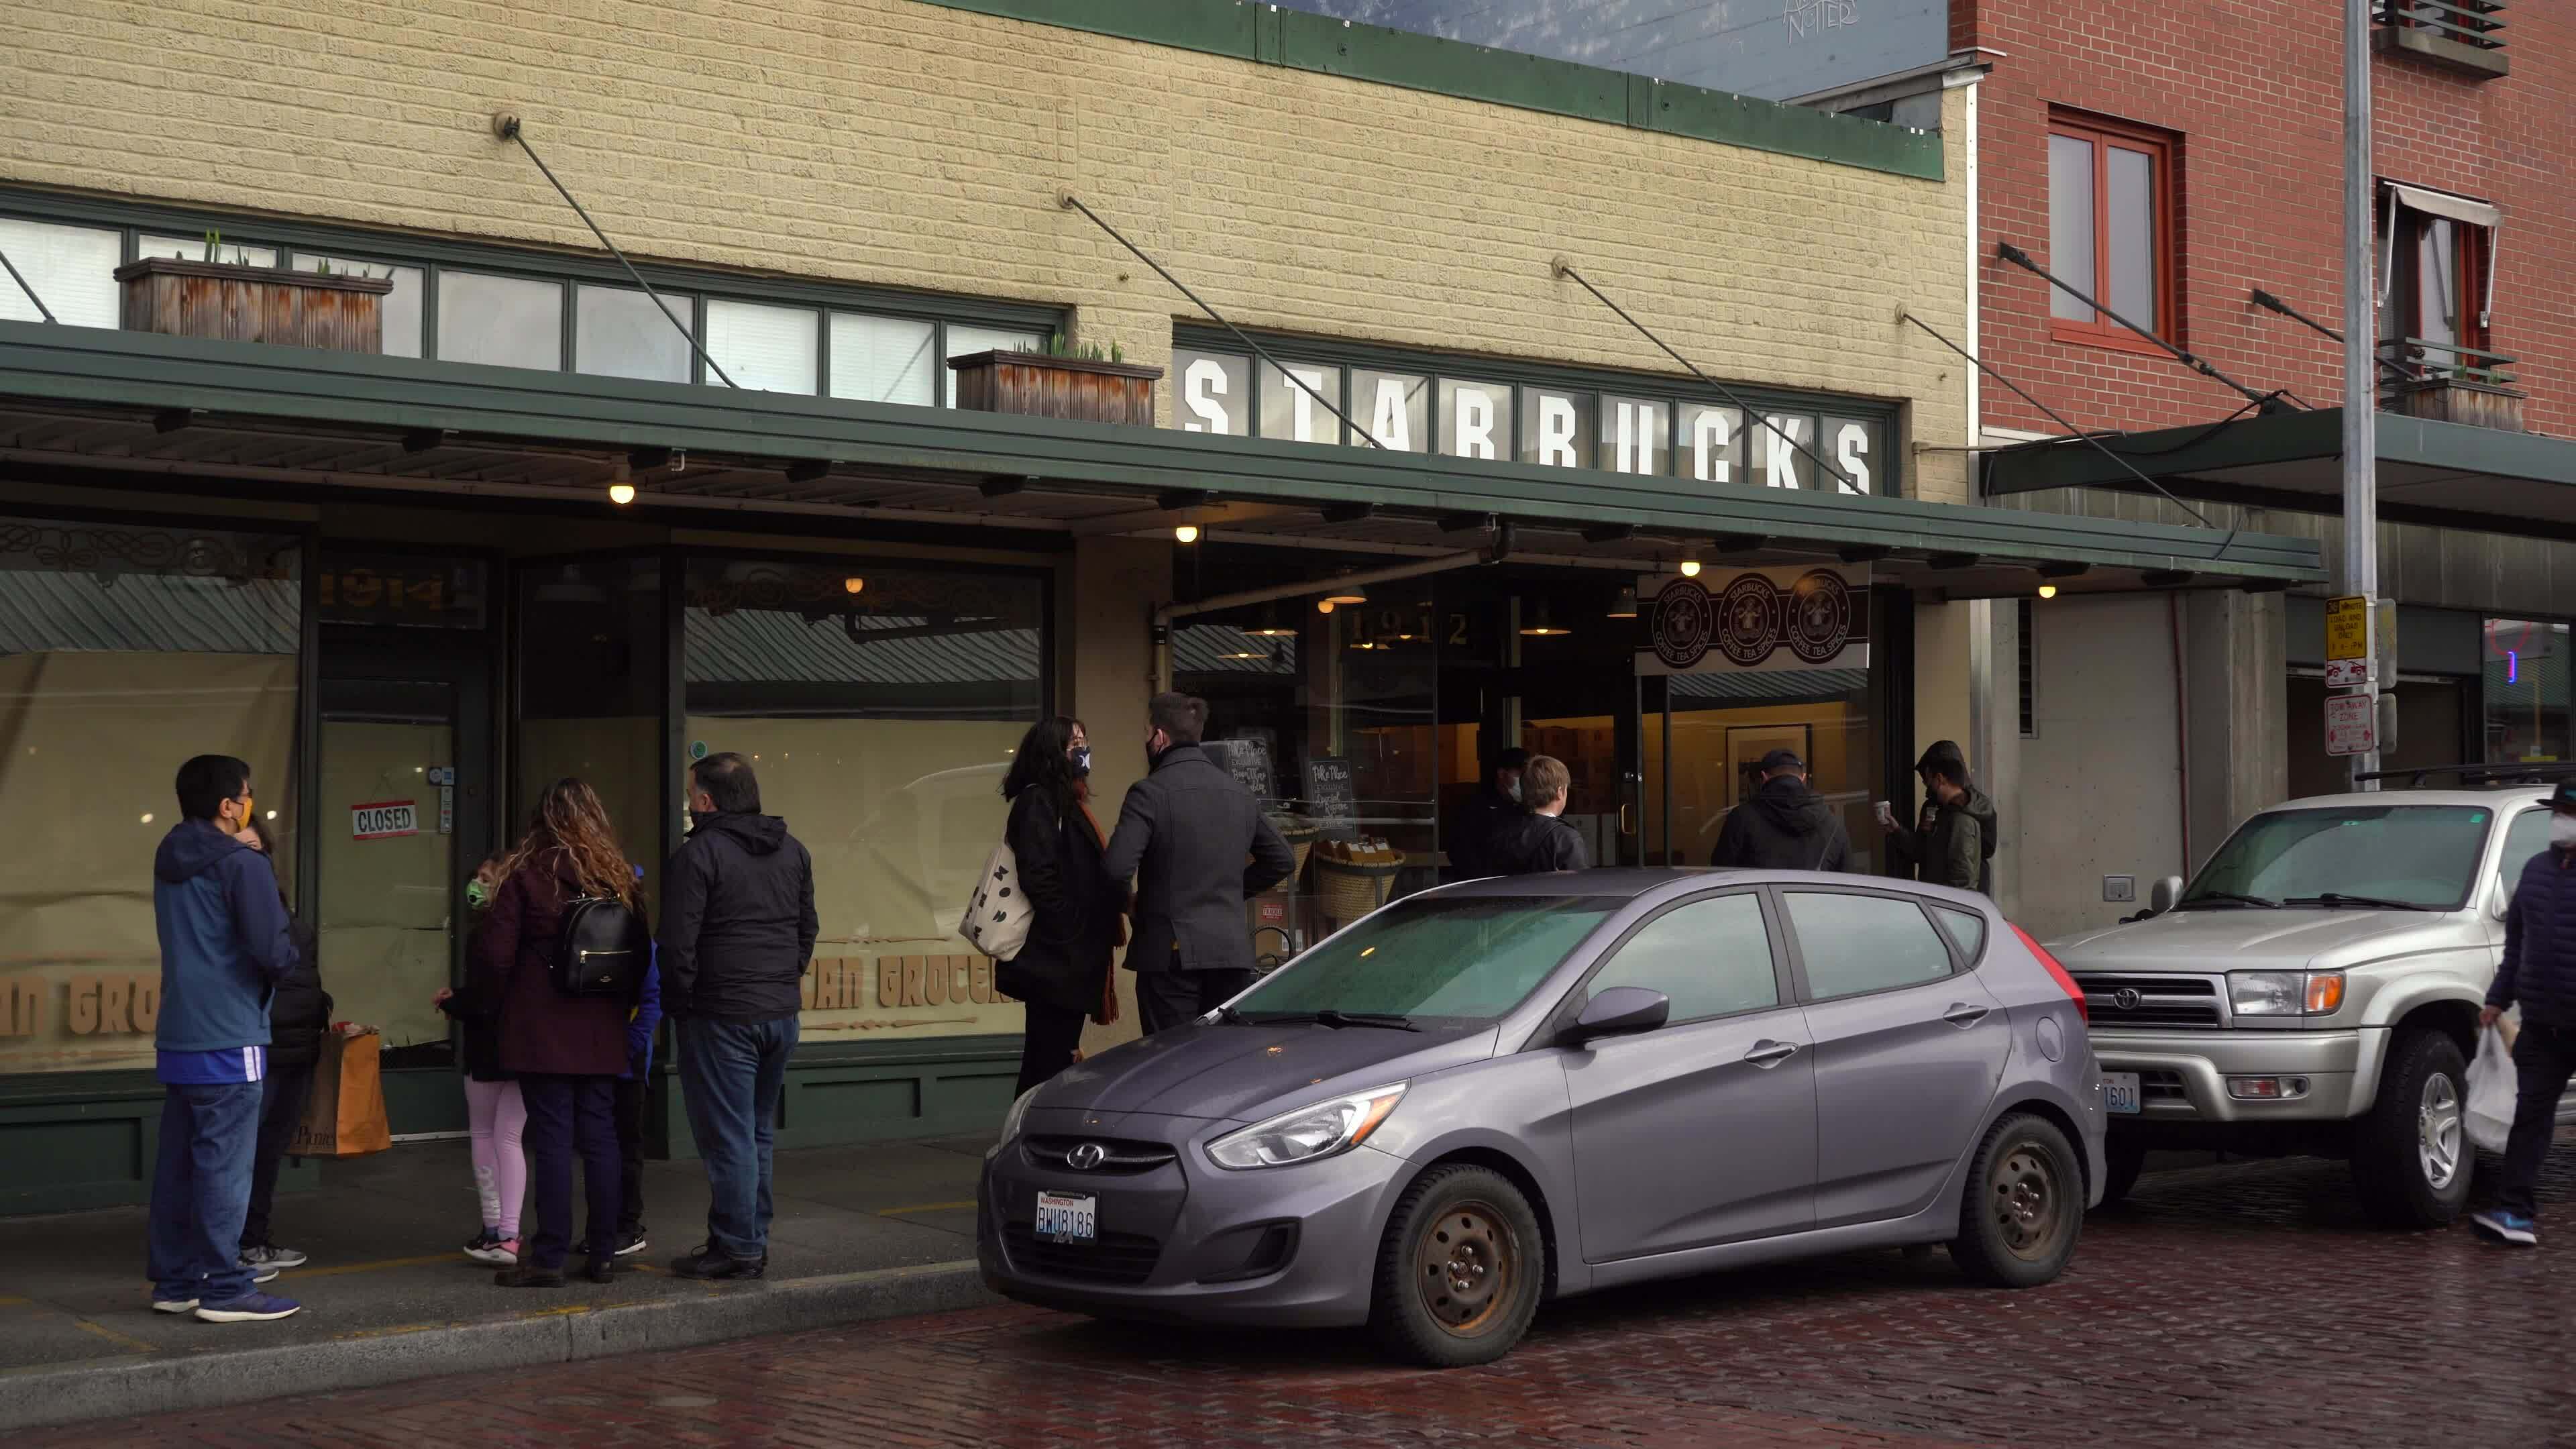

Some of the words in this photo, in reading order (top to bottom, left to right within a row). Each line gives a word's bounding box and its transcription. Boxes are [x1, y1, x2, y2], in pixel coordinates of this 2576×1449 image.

[1185, 359, 1870, 495] STARBUCKS
[1663, 584, 1703, 604] STARBUCKS
[1729, 582, 1771, 602] STARBUCKS
[1352, 610, 1467, 645] 1912
[1789, 625, 1811, 656] COFFEE
[1812, 646, 1827, 656] TEA
[1827, 624, 1847, 654] SPICES
[1654, 632, 1676, 659] COFFEE
[1676, 652, 1690, 661] TEA
[1690, 628, 1709, 658] SPICES
[1721, 627, 1742, 658] COFFEE
[1743, 649, 1757, 659] TEA
[1757, 627, 1778, 656] SPICES
[2339, 713, 2359, 722] ZONE
[358, 808, 411, 833] CLOSED
[1040, 1196, 1074, 1207] WASHINGTON
[1038, 1207, 1093, 1236] BWU8186
